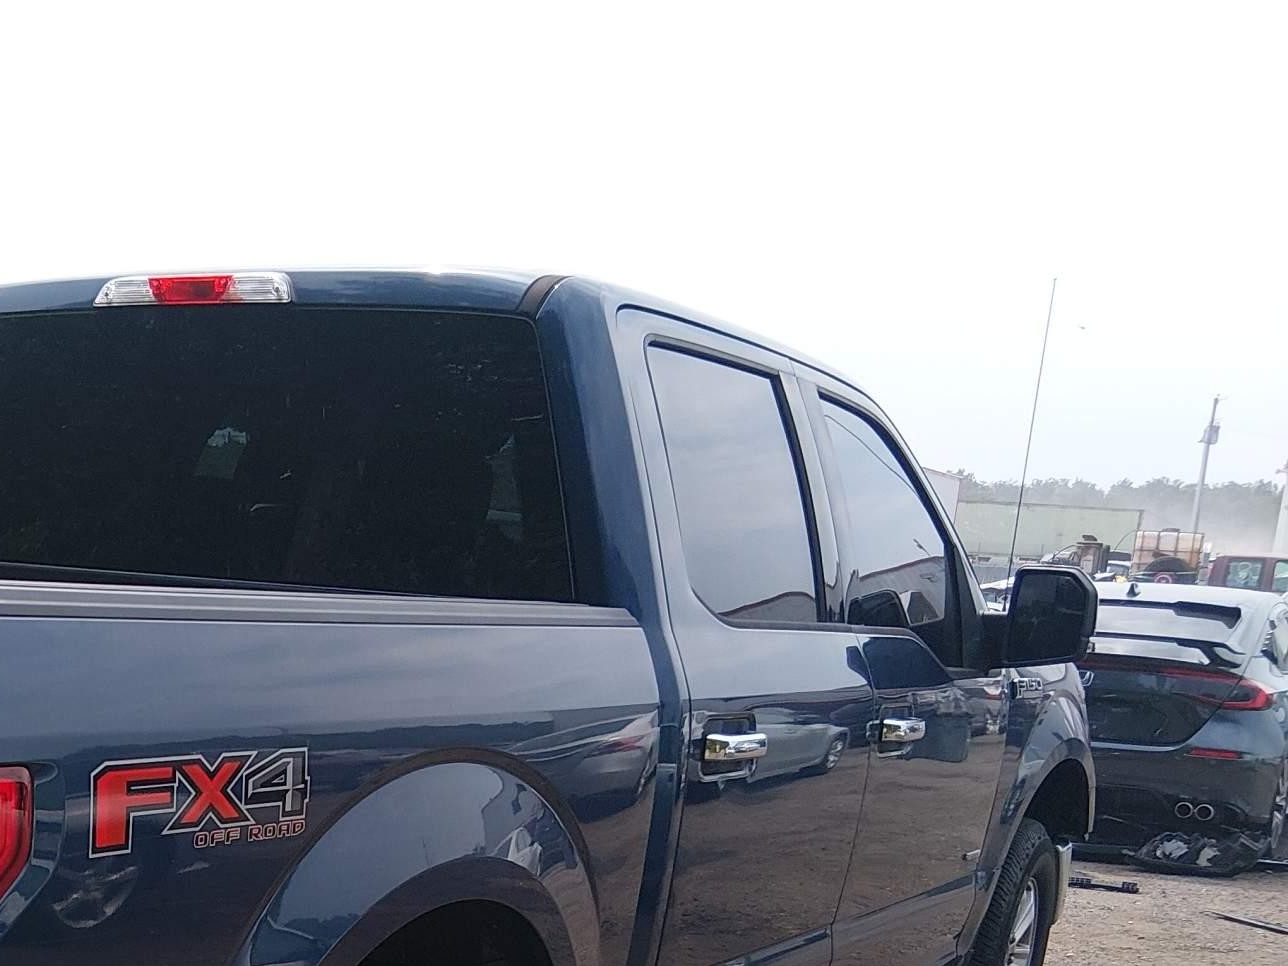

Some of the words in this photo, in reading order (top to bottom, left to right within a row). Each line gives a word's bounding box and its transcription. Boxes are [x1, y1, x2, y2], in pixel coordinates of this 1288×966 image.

[89, 747, 310, 859] FX4
[193, 828, 241, 849] OFF
[247, 819, 306, 842] ROAD
